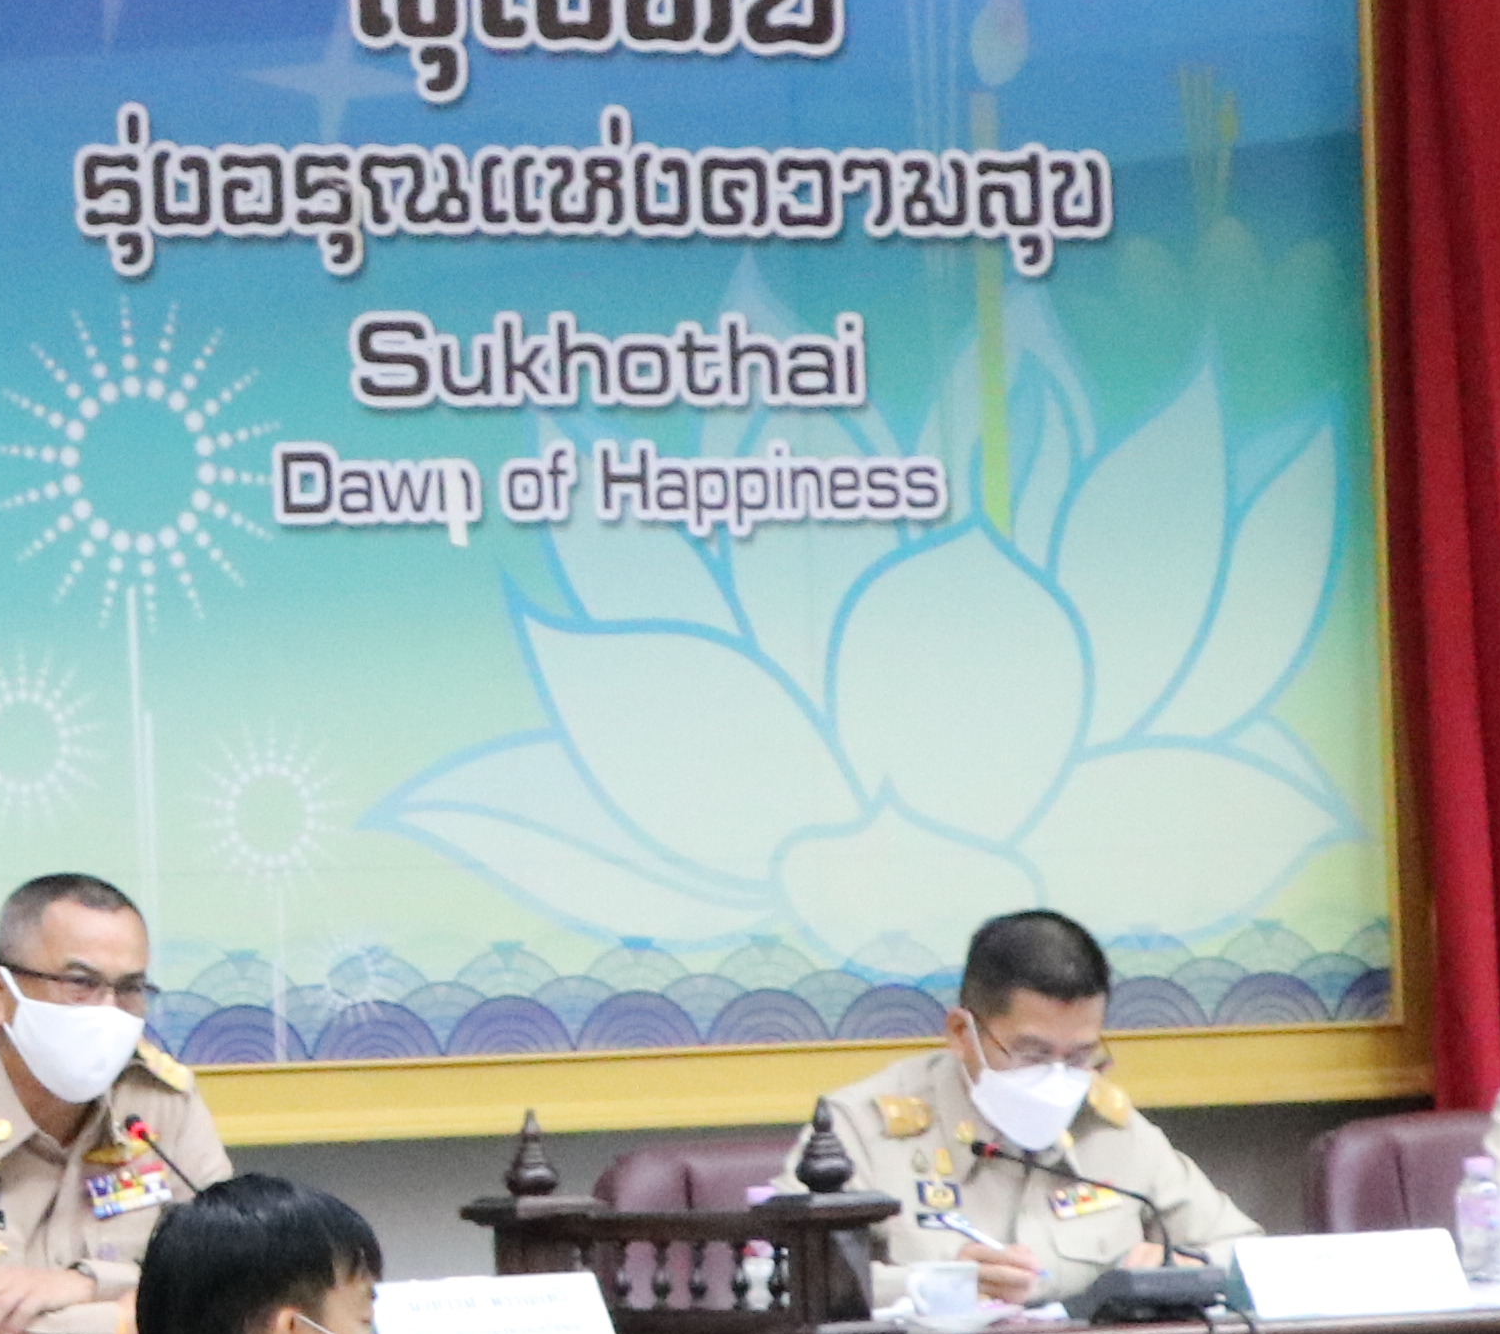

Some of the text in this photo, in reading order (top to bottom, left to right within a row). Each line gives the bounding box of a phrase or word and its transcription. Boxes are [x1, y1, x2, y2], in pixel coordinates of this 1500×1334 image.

[81, 113, 1106, 269] รุ่งอรุณแห่งความสุข
[356, 314, 865, 400] Sukhothai
[278, 448, 941, 534] Dawn of Happiness
